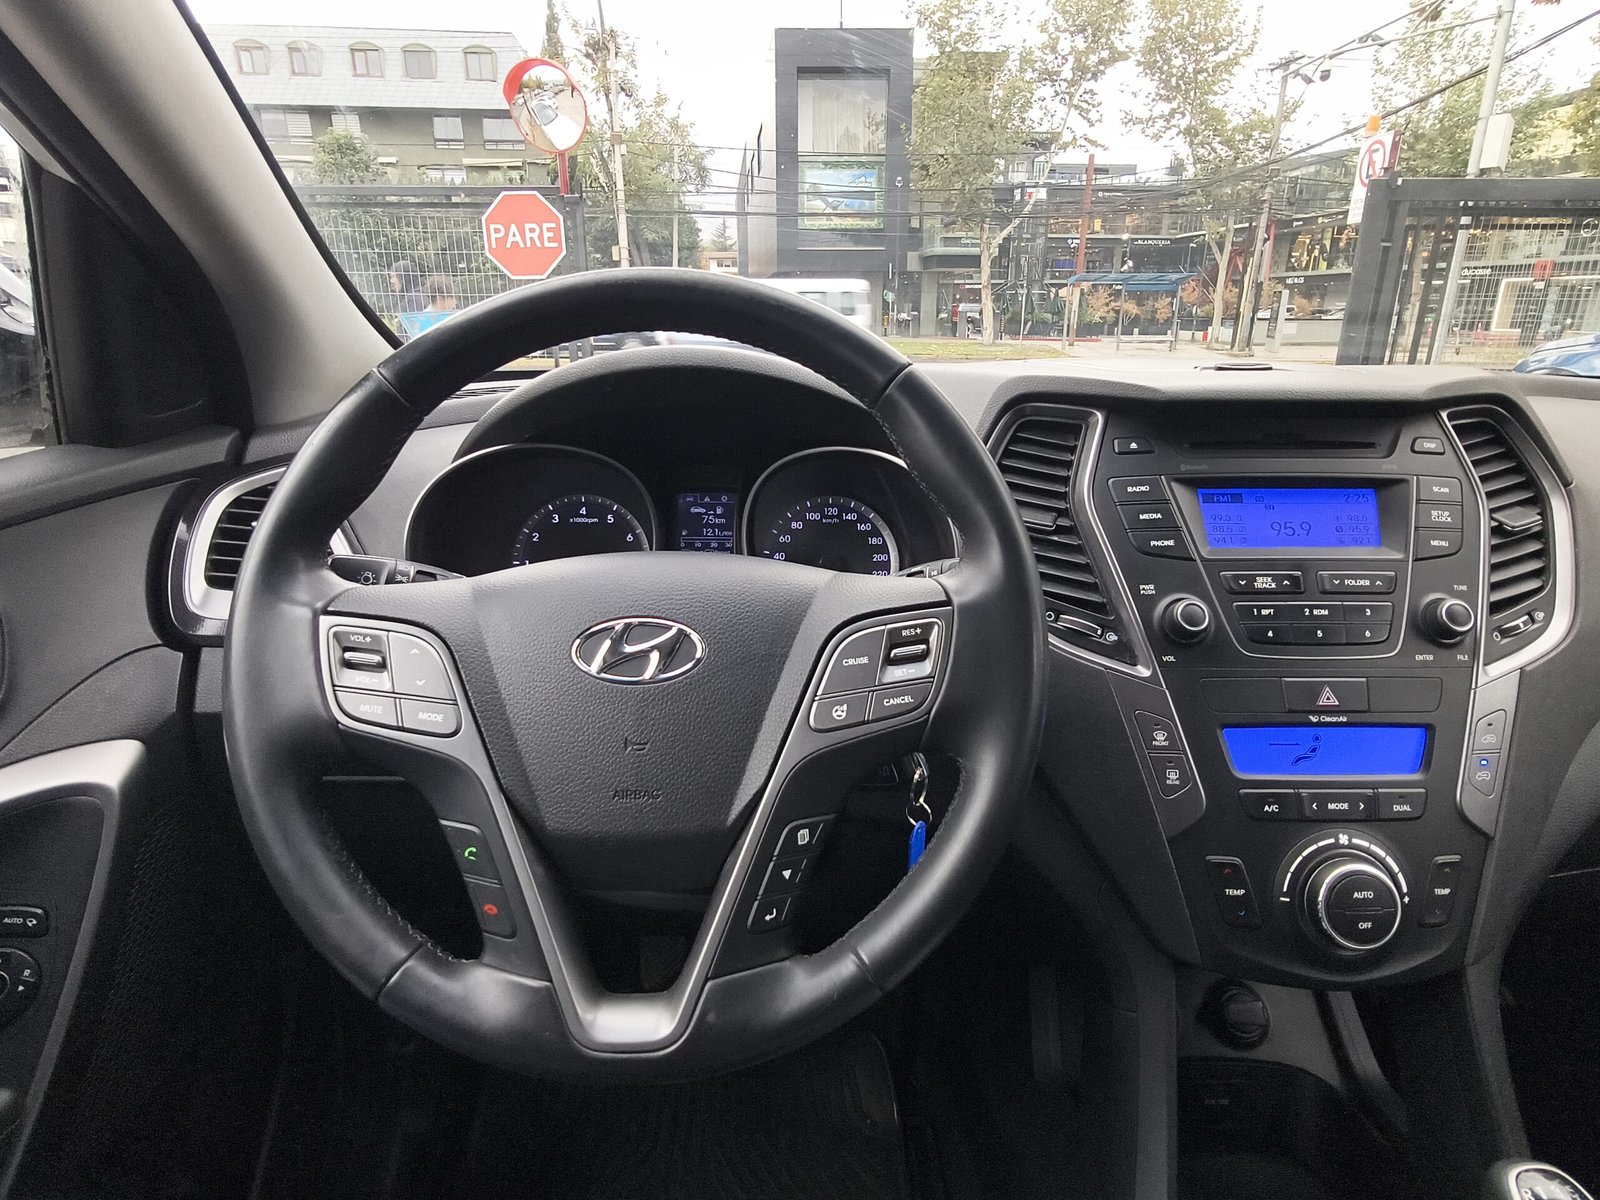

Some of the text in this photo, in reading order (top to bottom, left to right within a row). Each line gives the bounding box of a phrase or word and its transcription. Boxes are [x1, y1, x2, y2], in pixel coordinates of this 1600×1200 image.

[489, 223, 559, 249] PARE
[1344, 493, 1370, 502] 2:25
[579, 506, 587, 515] 4
[824, 508, 838, 516] 120
[552, 514, 559, 523] 3
[607, 514, 614, 523] 5
[805, 512, 820, 520] 100
[842, 512, 858, 520] 140
[790, 522, 803, 530] 80
[856, 523, 872, 531] 160
[1270, 521, 1312, 536] 95.9
[532, 533, 540, 542] 2
[626, 534, 634, 542] 6
[778, 535, 791, 543] 60
[868, 537, 883, 545] 180
[773, 552, 786, 560] 40
[872, 554, 888, 562] 200
[842, 656, 870, 666] CRUISE
[883, 697, 914, 706] CANCEL
[360, 703, 384, 714] MUTE
[418, 711, 444, 722] MODE
[612, 790, 662, 801] AIRBAG
[23, 969, 31, 977] R
